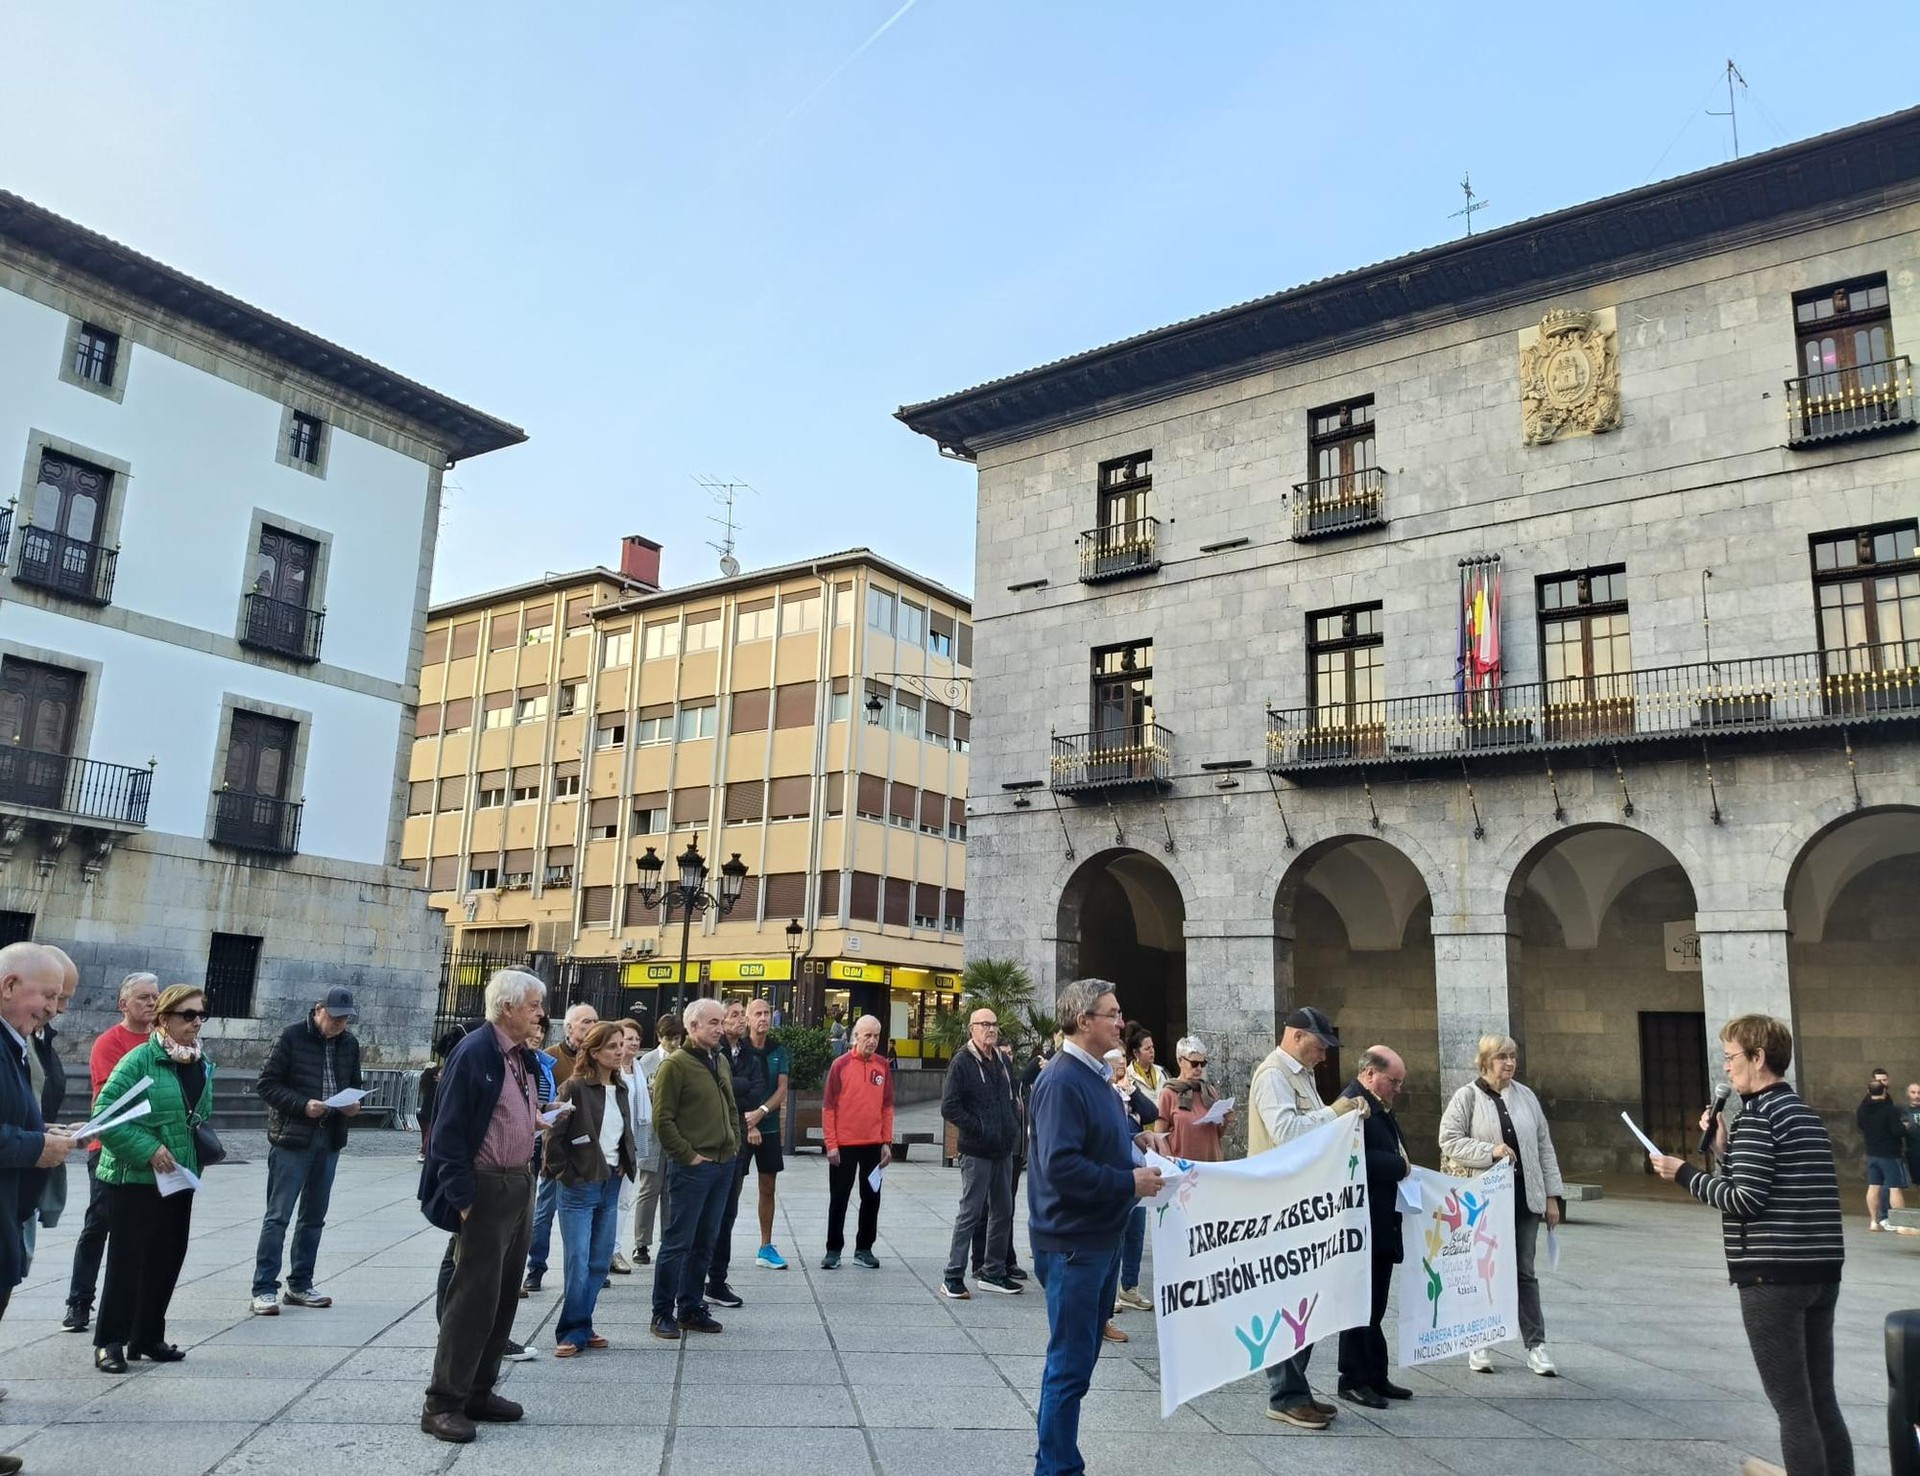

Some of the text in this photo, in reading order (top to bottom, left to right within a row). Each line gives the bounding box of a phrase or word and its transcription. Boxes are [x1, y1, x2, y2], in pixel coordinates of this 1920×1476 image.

[657, 967, 671, 978] BM
[749, 965, 764, 975] BM
[1418, 1327, 1453, 1343] HARRERA
[1453, 1323, 1466, 1337] ETA
[1453, 1339, 1459, 1350] Y
[1460, 1326, 1506, 1349] HOSPITALIDAD
